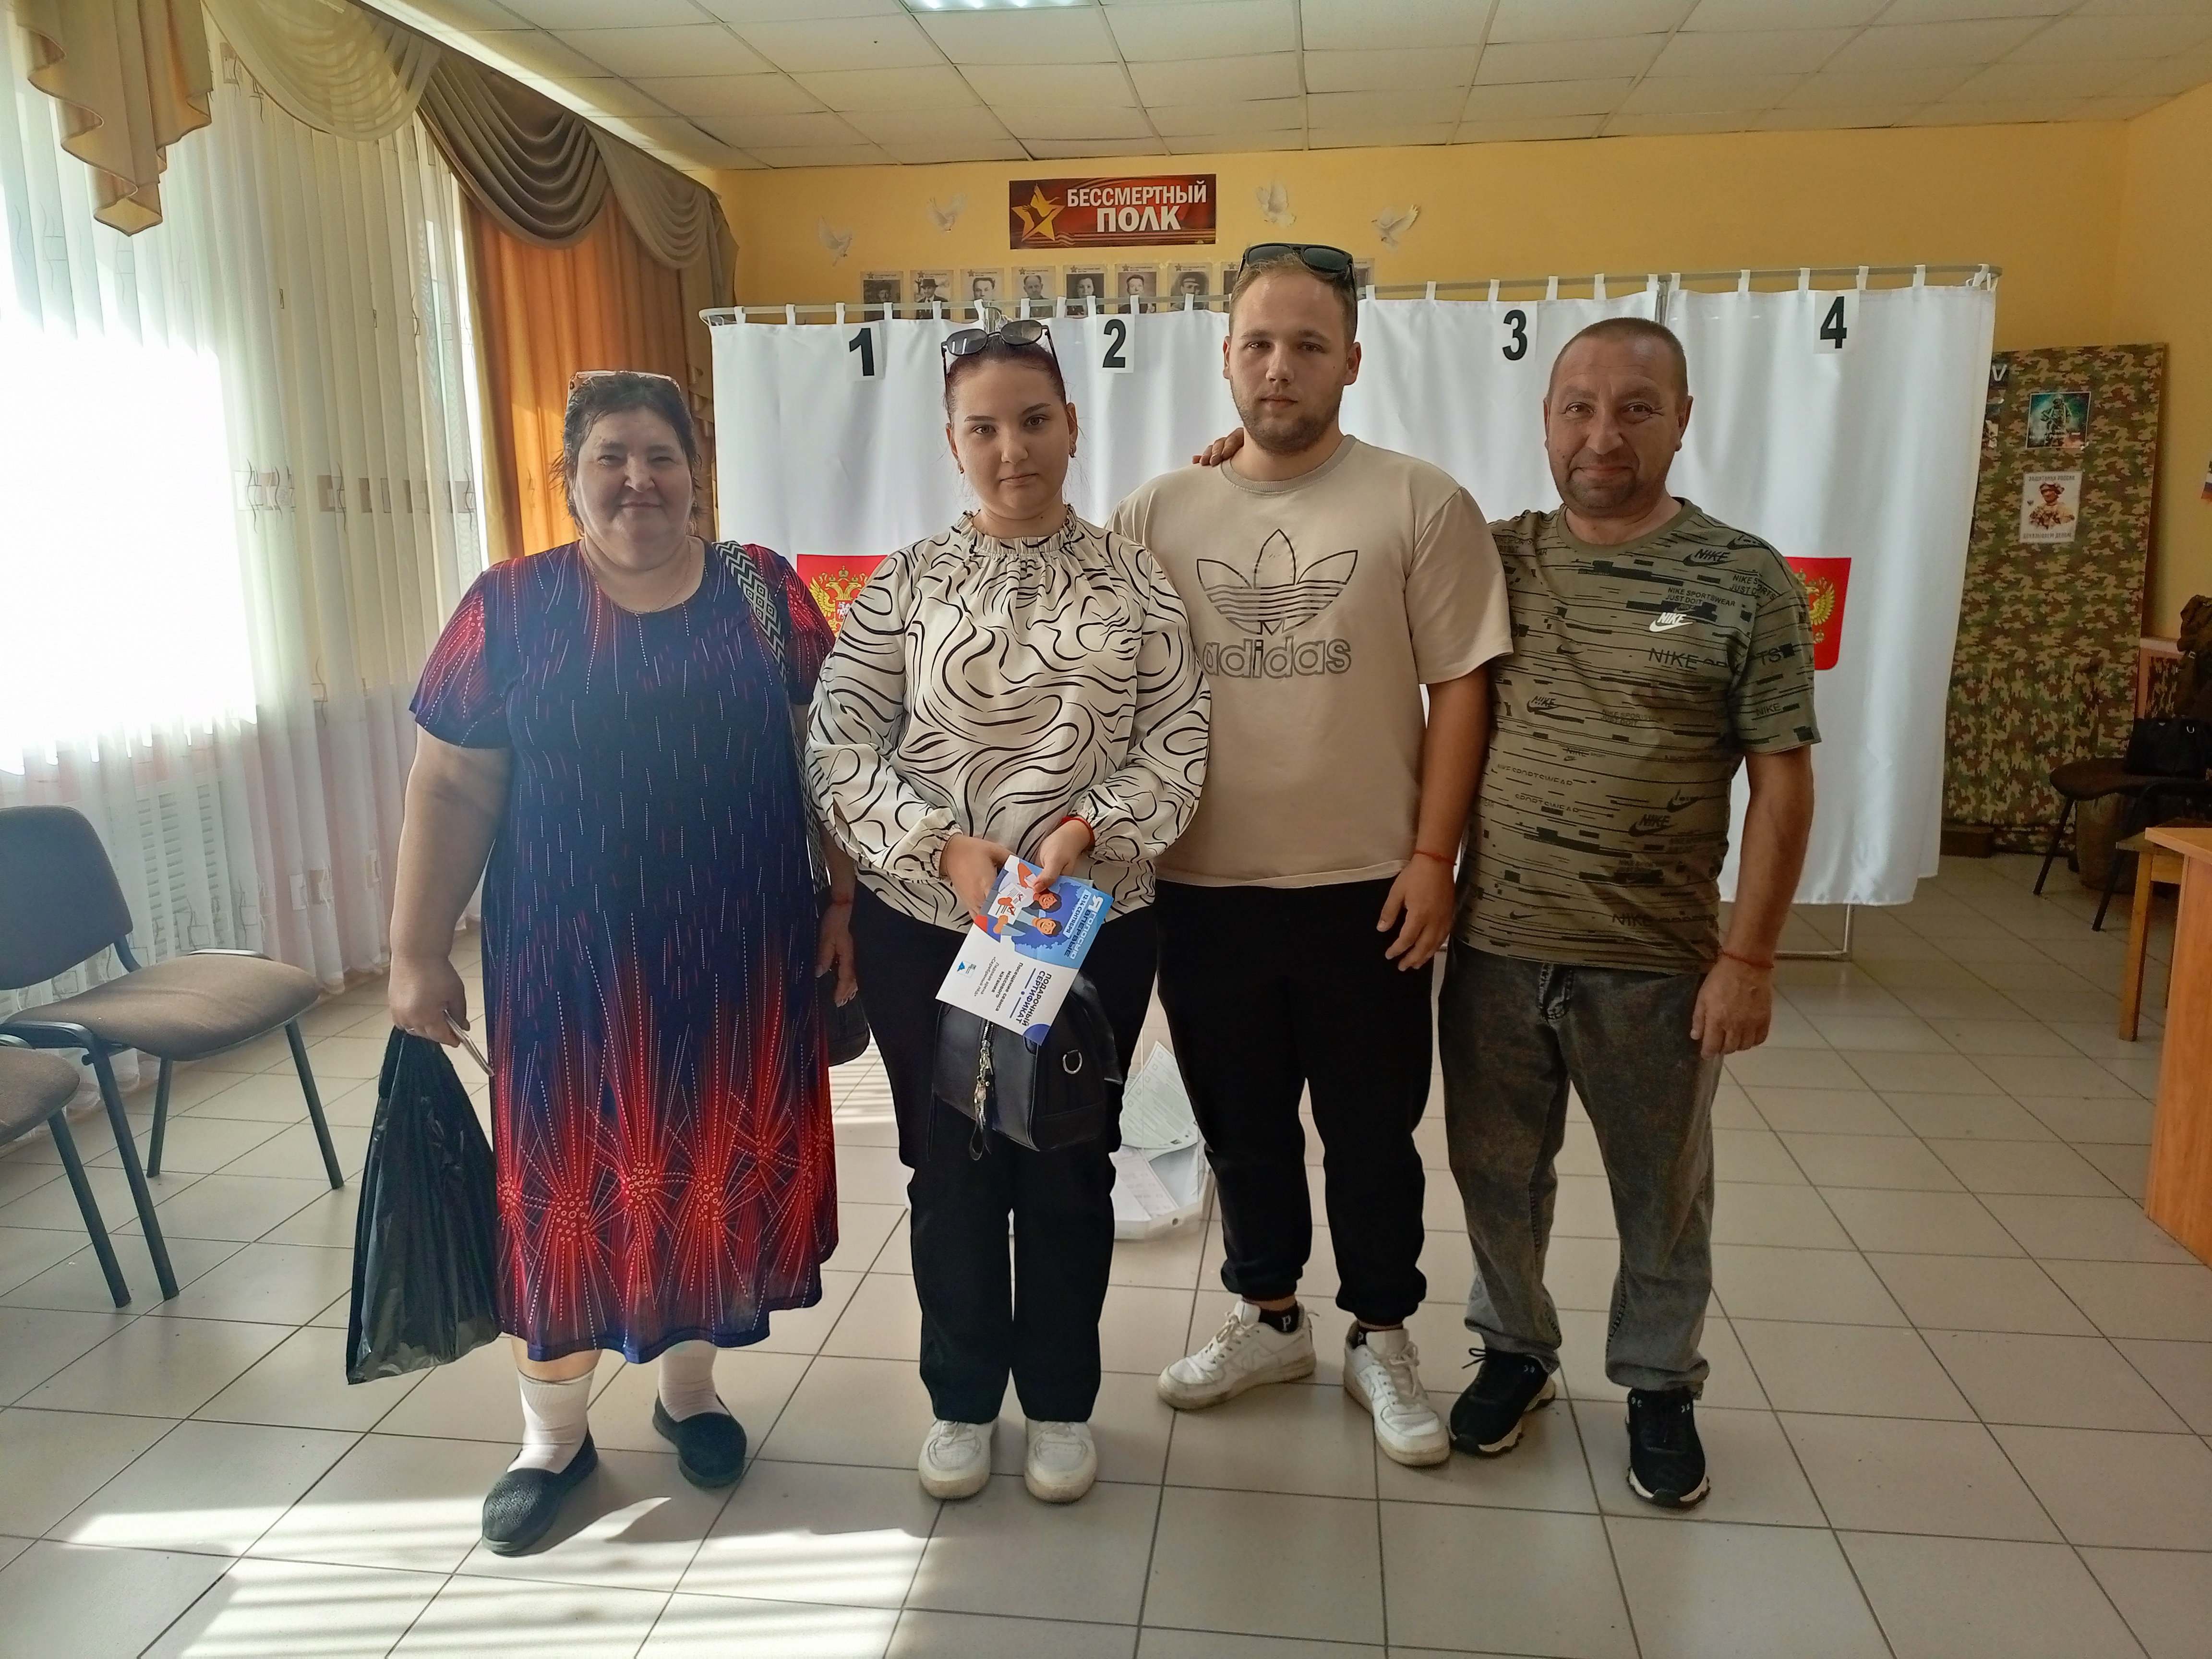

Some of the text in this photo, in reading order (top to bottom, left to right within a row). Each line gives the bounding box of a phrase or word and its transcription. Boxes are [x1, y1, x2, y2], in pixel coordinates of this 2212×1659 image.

[1067, 180, 1207, 207] БЕССМЕРТНЫЙ
[1096, 205, 1181, 232] ПОЛК
[1502, 309, 1528, 361] 3
[1820, 296, 1847, 349] 4
[849, 327, 875, 376] 1
[1102, 319, 1127, 368] 2
[1695, 549, 1731, 562] NIKE
[1729, 584, 1750, 594] JUST
[1732, 574, 1752, 584] NIKE
[1668, 586, 1685, 595] NIKE
[1686, 589, 1736, 607] SPORTSWEAR
[1657, 612, 1686, 624] NIKE
[1202, 636, 1352, 679] adidas
[1648, 648, 1698, 669] NIKE
[1531, 696, 1556, 707] NIKE
[1755, 703, 1780, 716] NIKE
[1064, 909, 1091, 957] ВПЕРВЫЕ
[1066, 906, 1082, 933] СЕНТЯБРЯ
[1070, 895, 1104, 960] Я ГОЛОСУЮ
[980, 962, 999, 995] Ледовая арена
[991, 971, 1005, 993] катания
[995, 962, 1023, 1011] Посещение сеанса
[996, 970, 1012, 998] массового
[1016, 971, 1046, 1024] СЕРТИФИКАТ
[1022, 973, 1052, 1027] ПОДАРОЧНЫЙ
